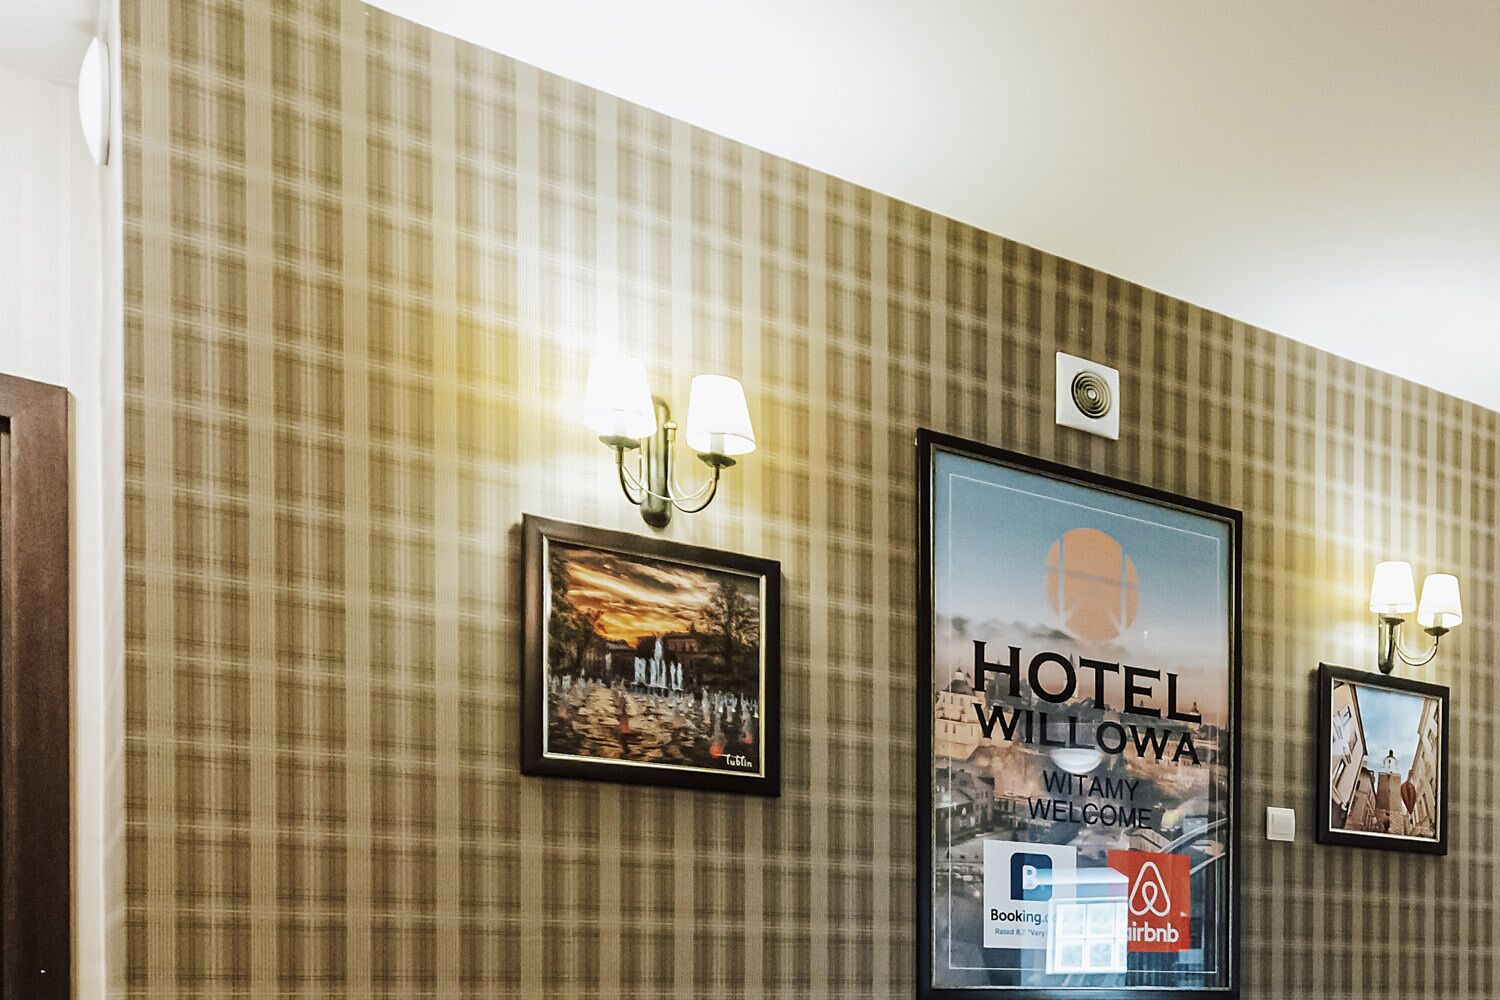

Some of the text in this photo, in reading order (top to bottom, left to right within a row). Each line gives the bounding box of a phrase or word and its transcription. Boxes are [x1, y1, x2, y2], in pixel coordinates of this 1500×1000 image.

[972, 640, 1202, 725] HOTEL
[972, 703, 1201, 765] WILLOWA
[1043, 769, 1140, 801] WITAMY
[1027, 797, 1153, 829] WELCOME
